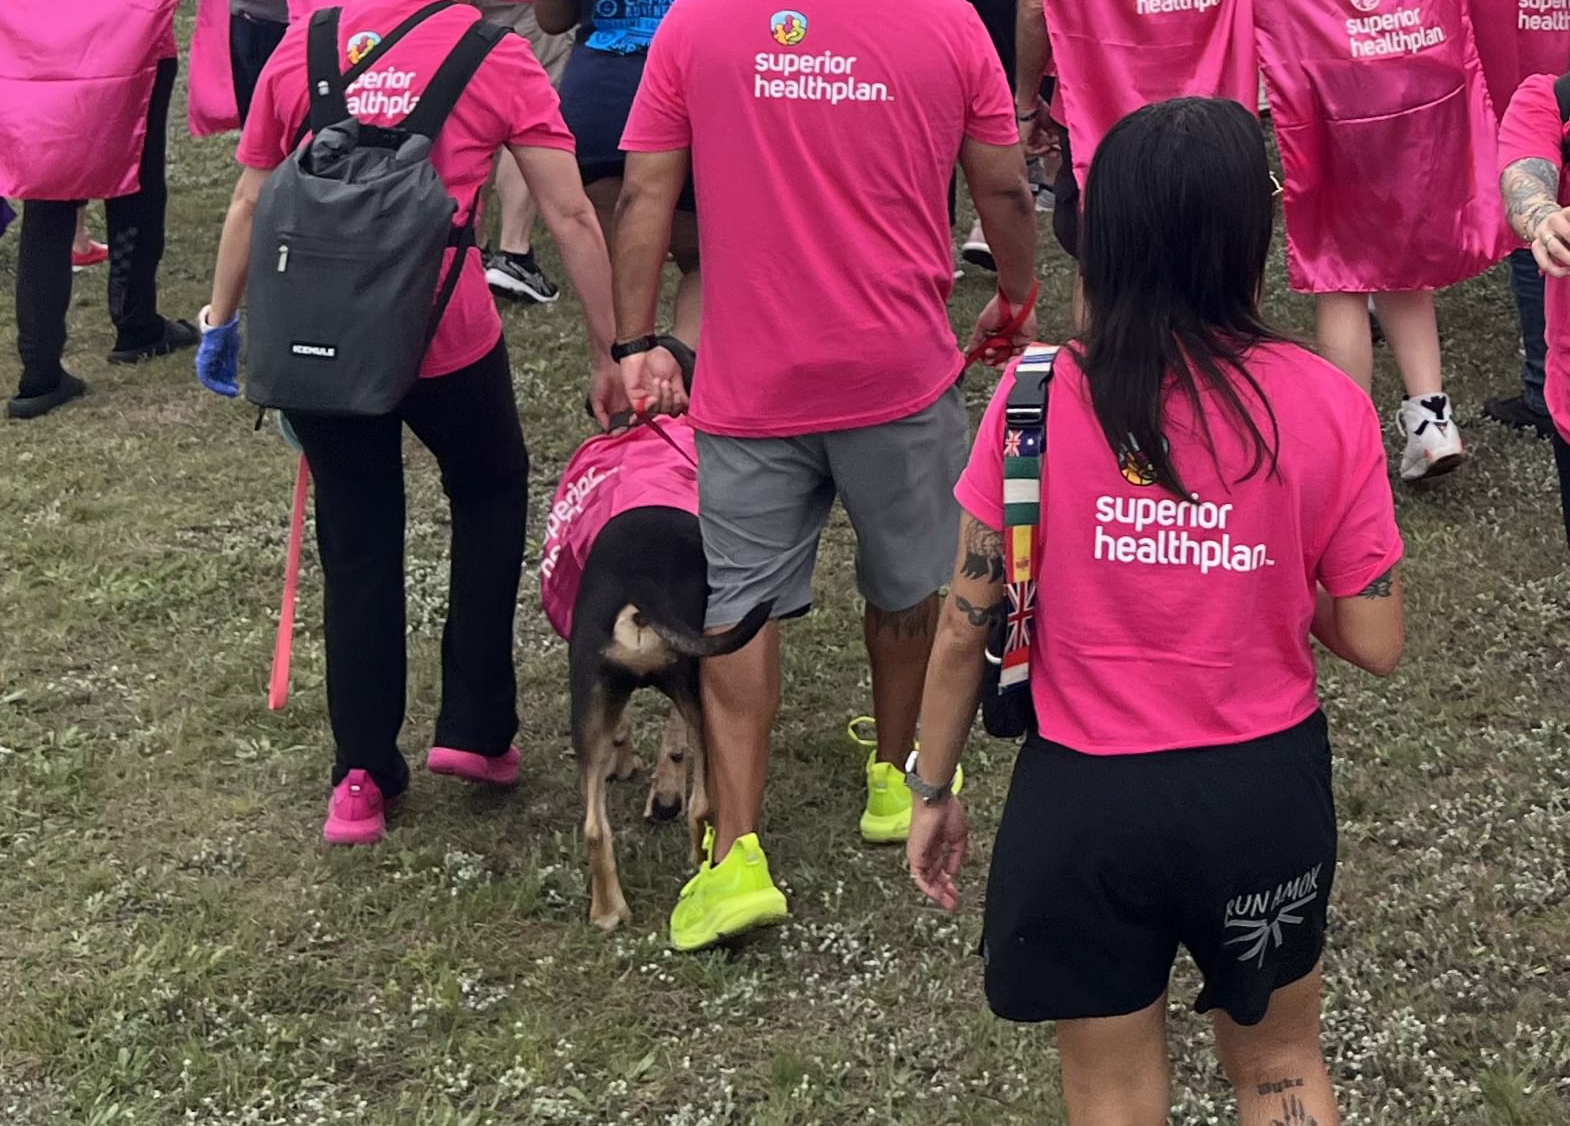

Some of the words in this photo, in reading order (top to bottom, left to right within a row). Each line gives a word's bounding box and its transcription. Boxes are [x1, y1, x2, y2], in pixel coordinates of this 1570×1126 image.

[1345, 7, 1420, 37] superior
[1349, 25, 1444, 58] healthplan
[755, 50, 857, 76] superior
[754, 74, 889, 105] healthplan
[292, 345, 335, 356] ICEMULE
[1095, 492, 1233, 532] superior
[1094, 525, 1267, 574] healthplan
[1225, 889, 1271, 923] RUN
[1270, 862, 1322, 911] AMOK
